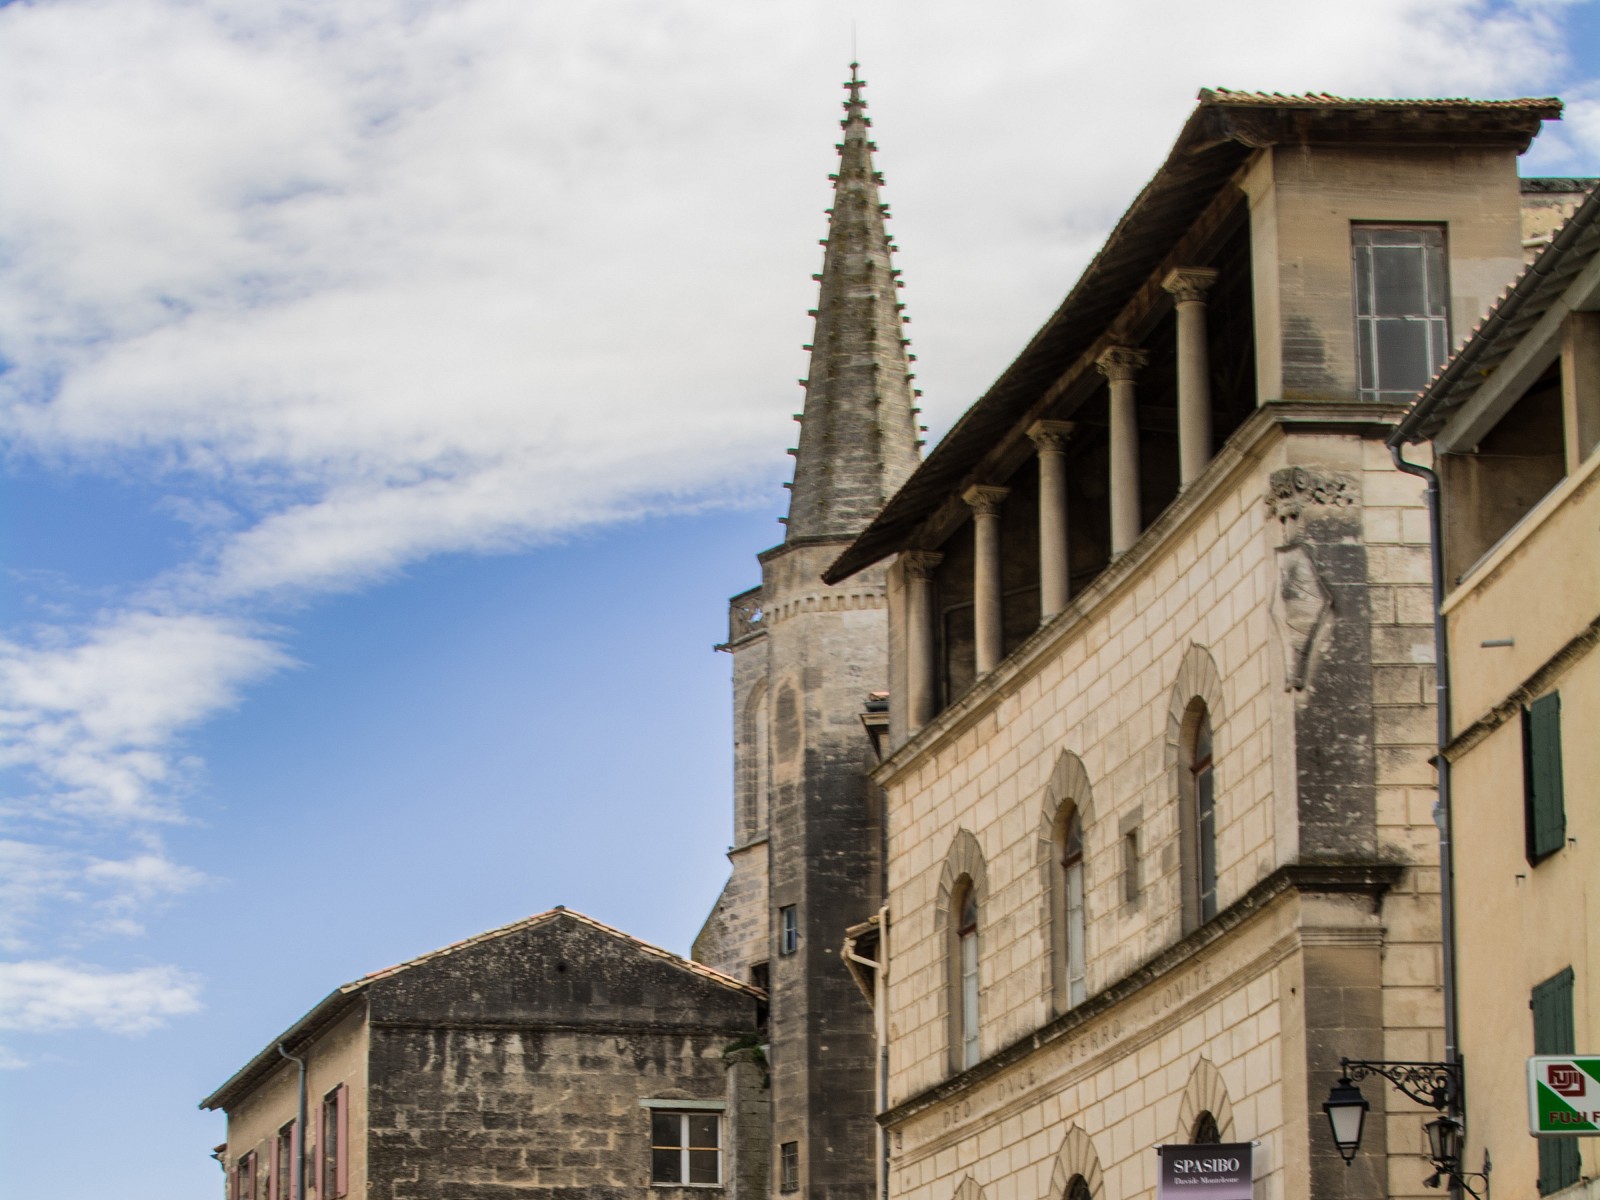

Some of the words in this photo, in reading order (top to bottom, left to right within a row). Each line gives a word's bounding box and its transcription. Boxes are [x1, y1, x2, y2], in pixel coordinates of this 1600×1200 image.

[1549, 1111, 1587, 1124] FUJI
[1174, 1157, 1240, 1174] SPASIBO
[1174, 1176, 1199, 1185] Davide
[1200, 1176, 1239, 1184] Monteleone
